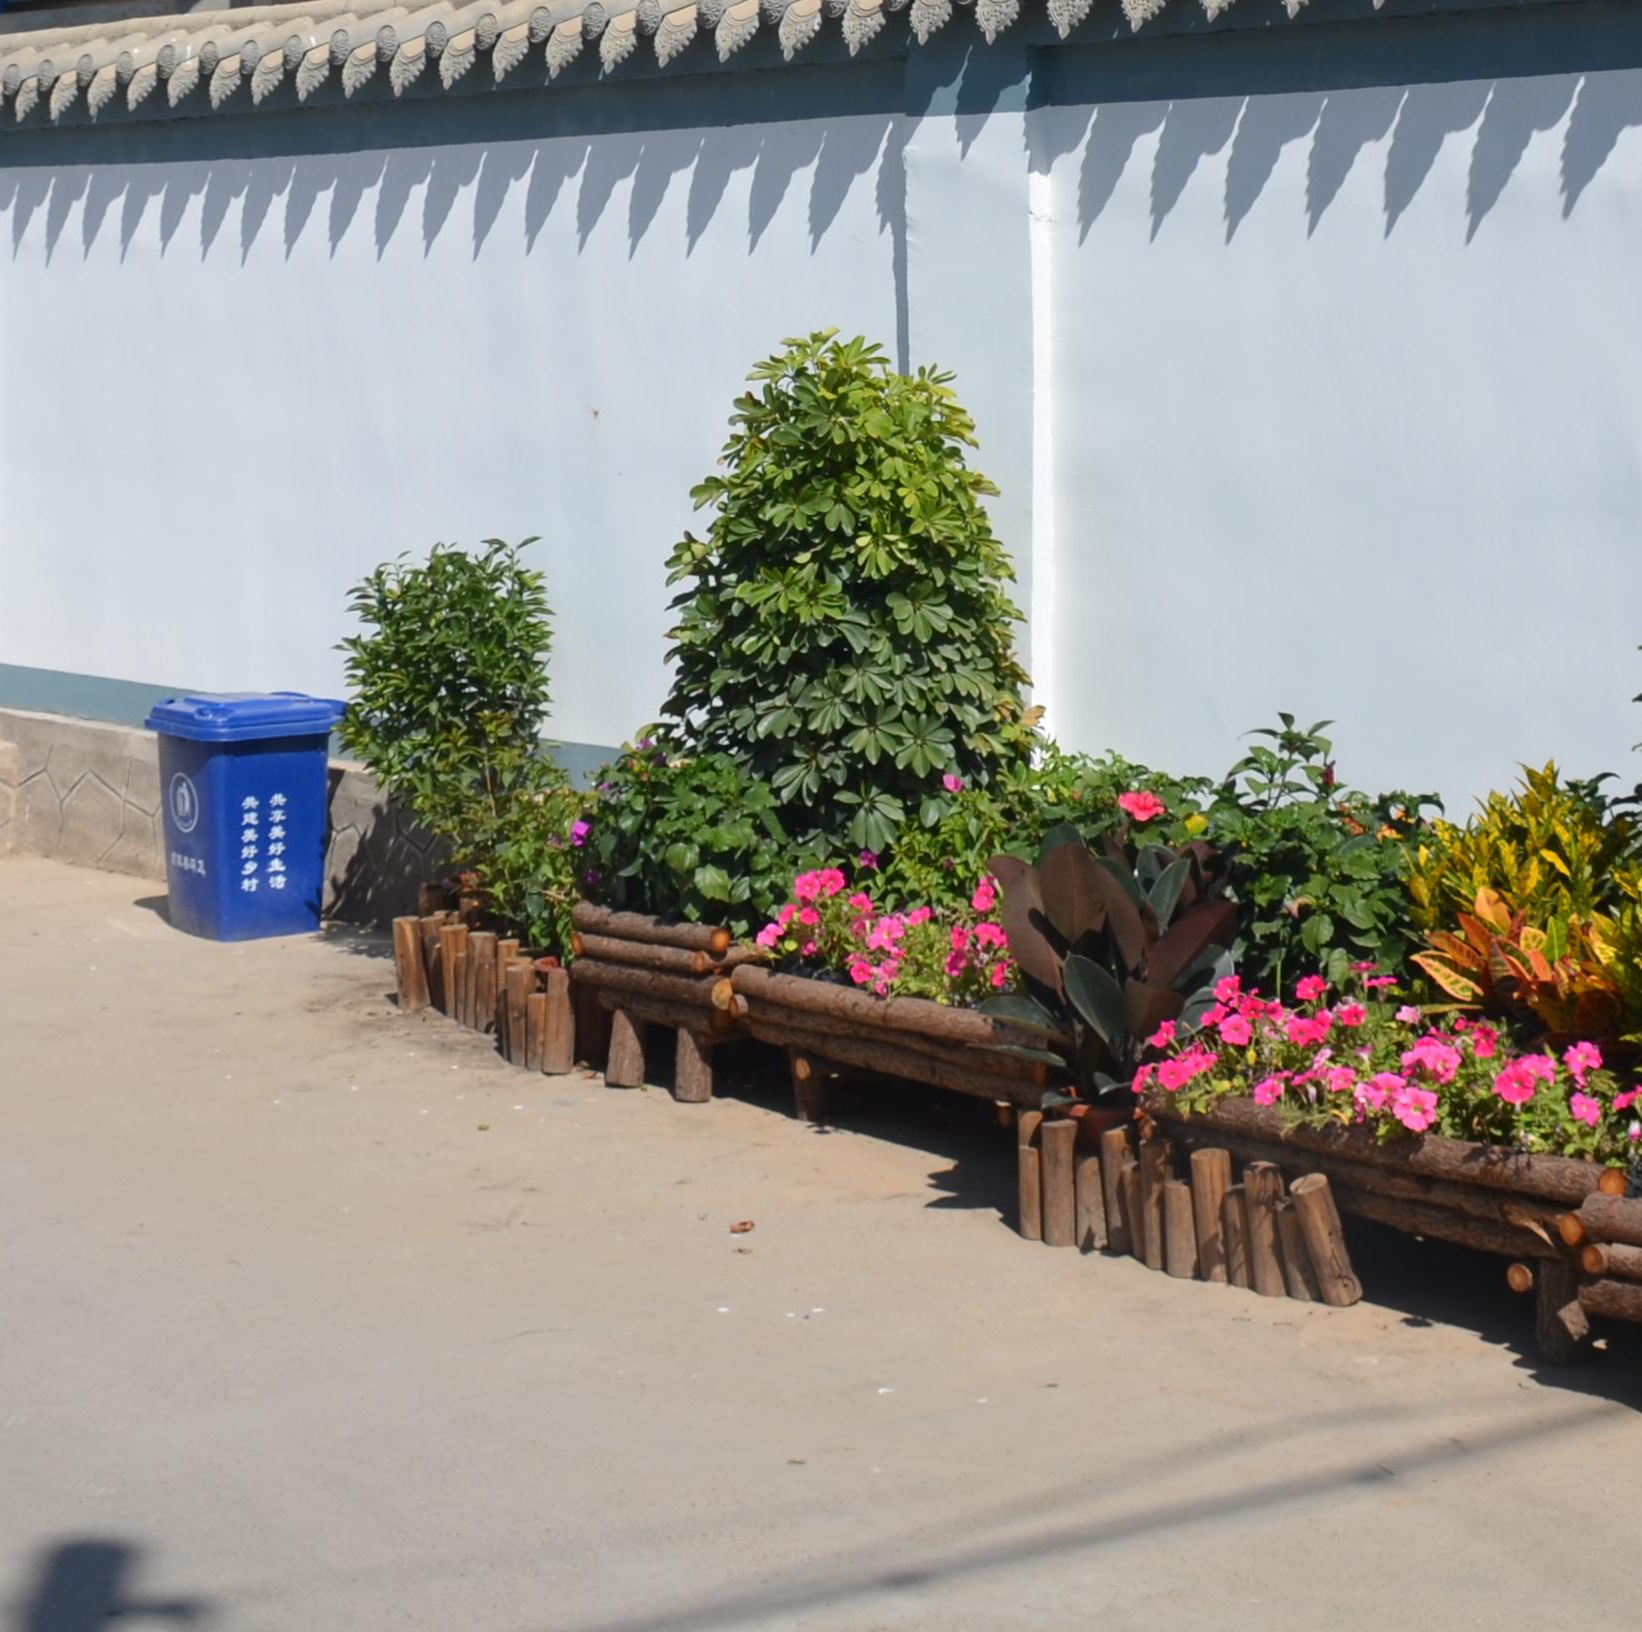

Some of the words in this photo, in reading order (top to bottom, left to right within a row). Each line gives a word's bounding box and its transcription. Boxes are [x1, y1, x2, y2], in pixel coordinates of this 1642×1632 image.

[241, 795, 259, 892] 共建美好乡村
[267, 792, 287, 890] 共享美好生活
